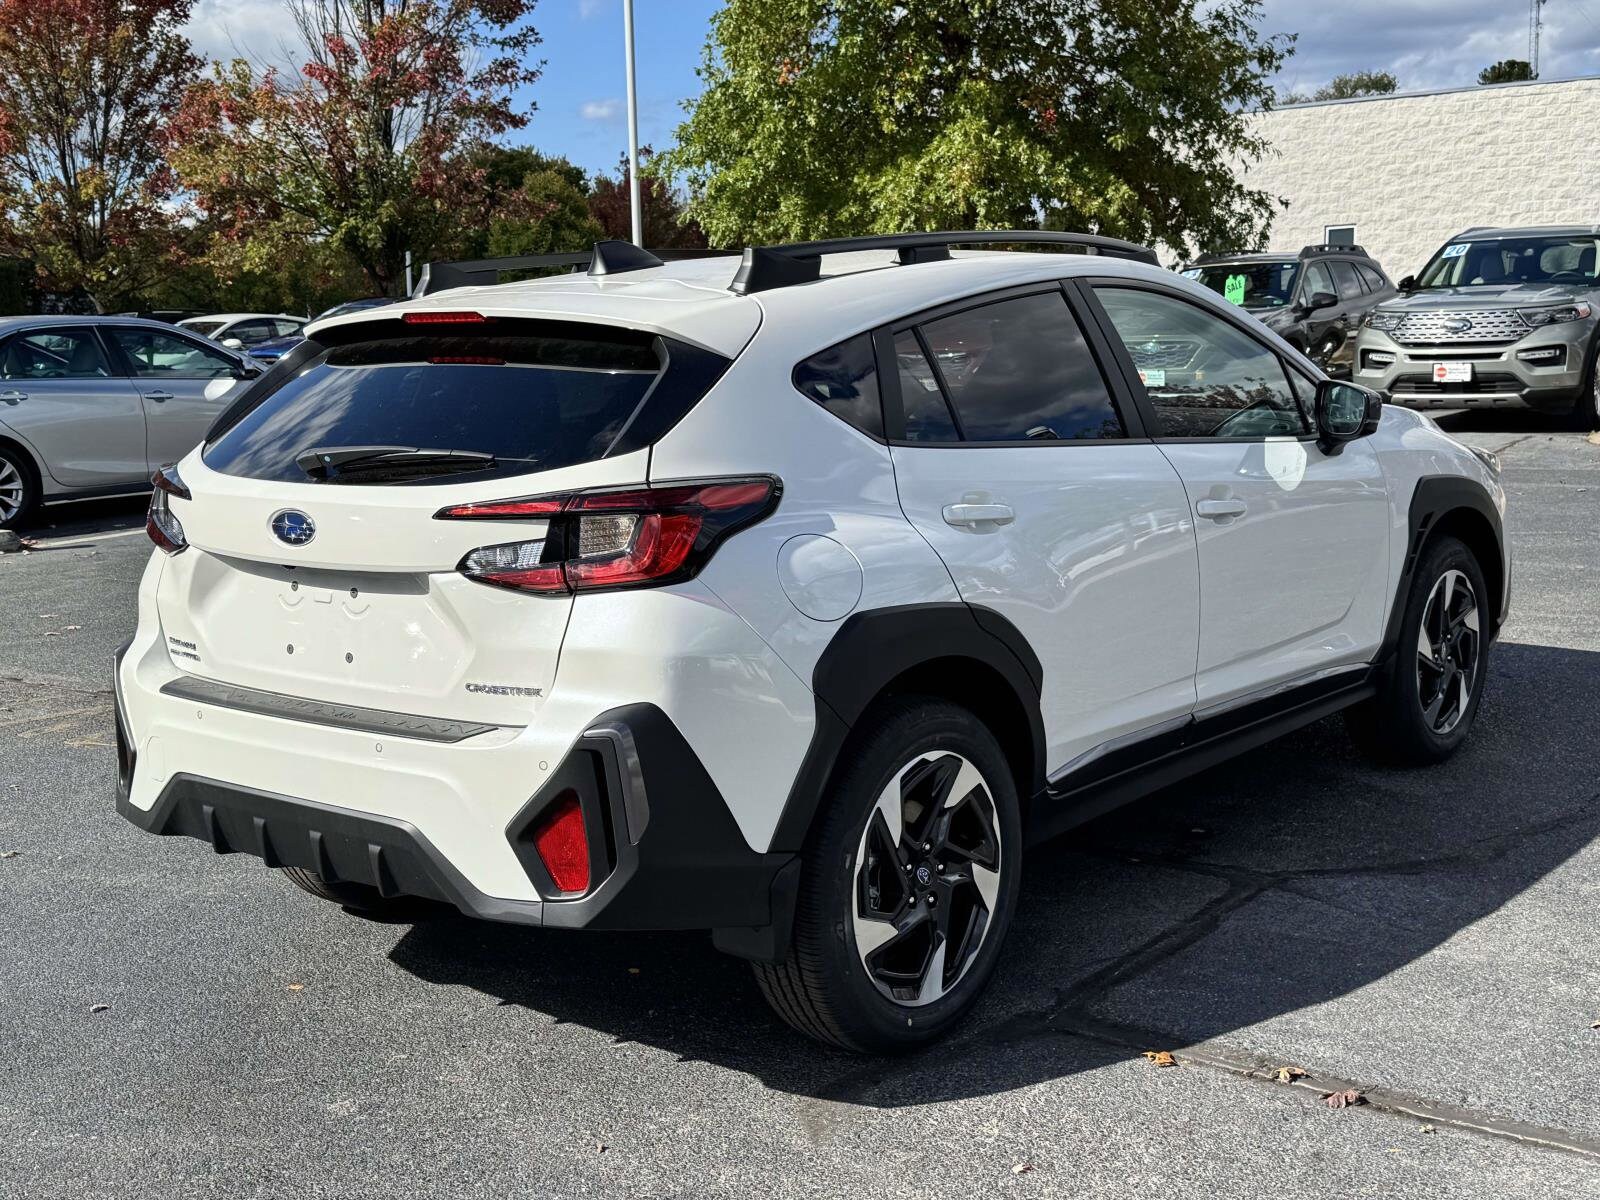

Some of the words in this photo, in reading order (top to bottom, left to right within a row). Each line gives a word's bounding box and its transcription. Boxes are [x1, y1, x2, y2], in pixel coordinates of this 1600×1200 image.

[1445, 245, 1467, 256] 20
[1226, 280, 1243, 294] SALE
[465, 682, 543, 698] CROSSTREK
